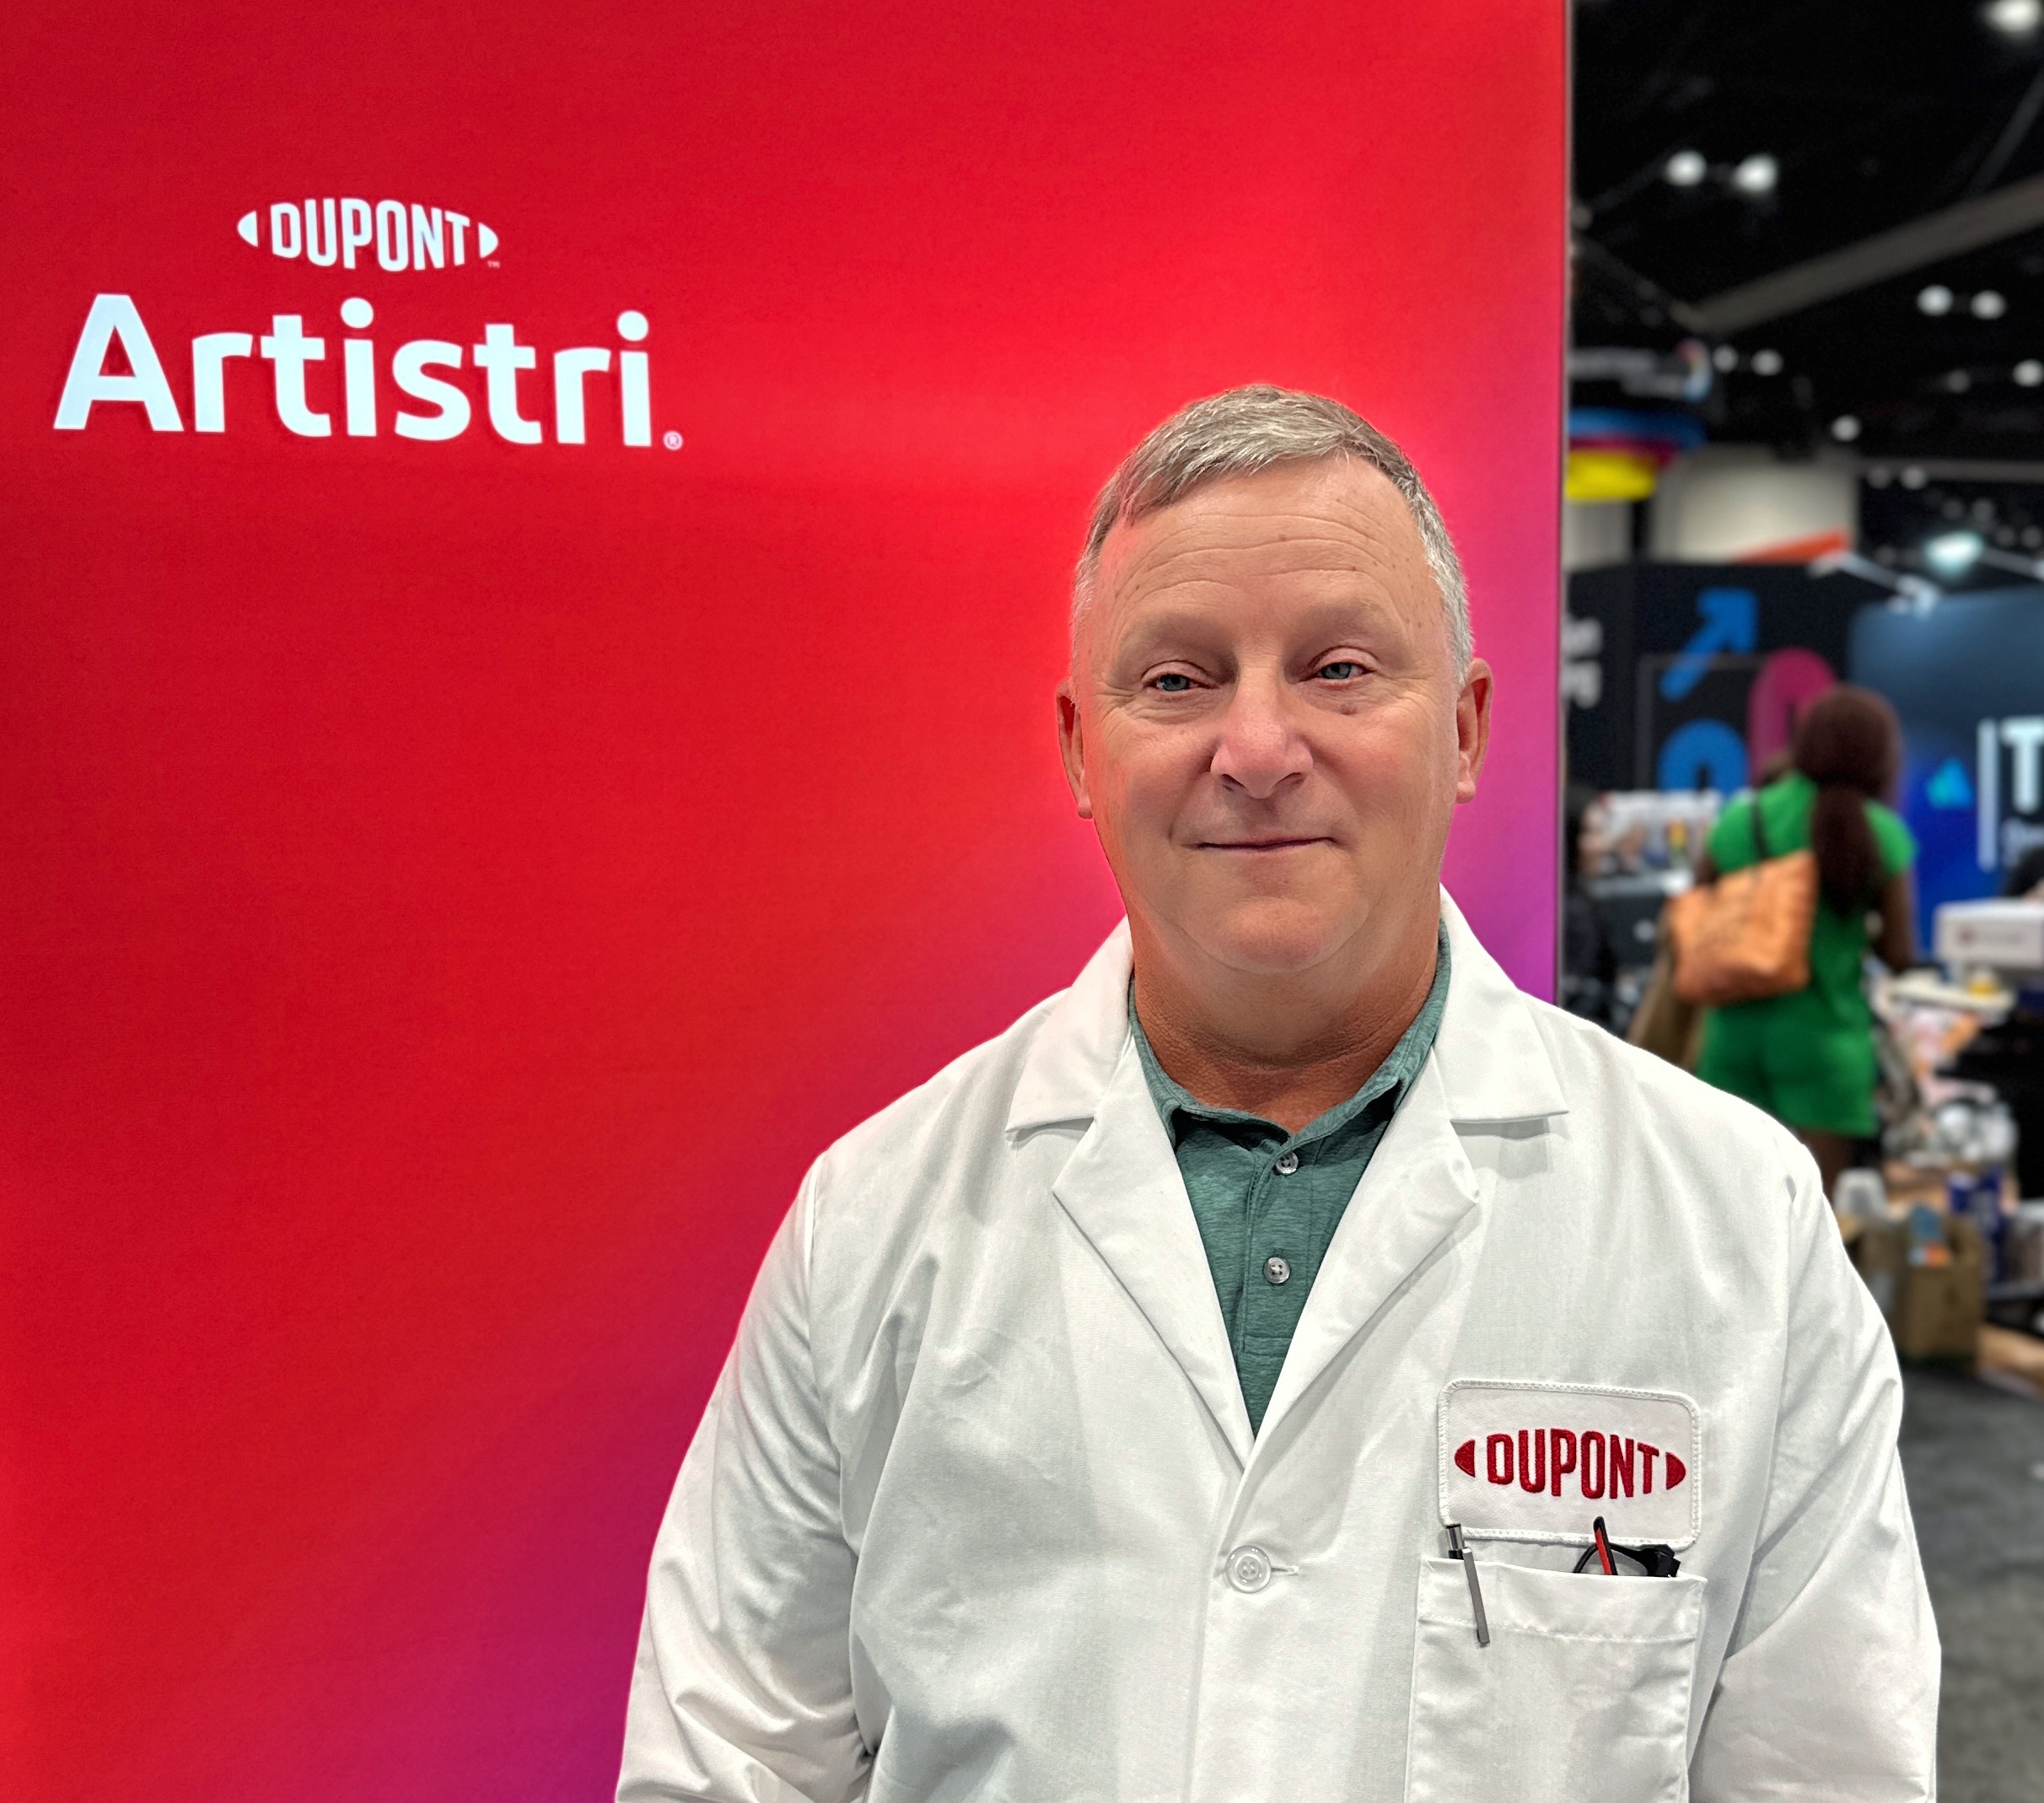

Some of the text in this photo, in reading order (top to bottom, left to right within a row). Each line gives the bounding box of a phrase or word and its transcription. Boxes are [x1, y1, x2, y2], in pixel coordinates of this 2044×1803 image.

[270, 197, 471, 272] DUPONT
[53, 293, 653, 447] Artistri
[1486, 1428, 1659, 1499] DUPONT
